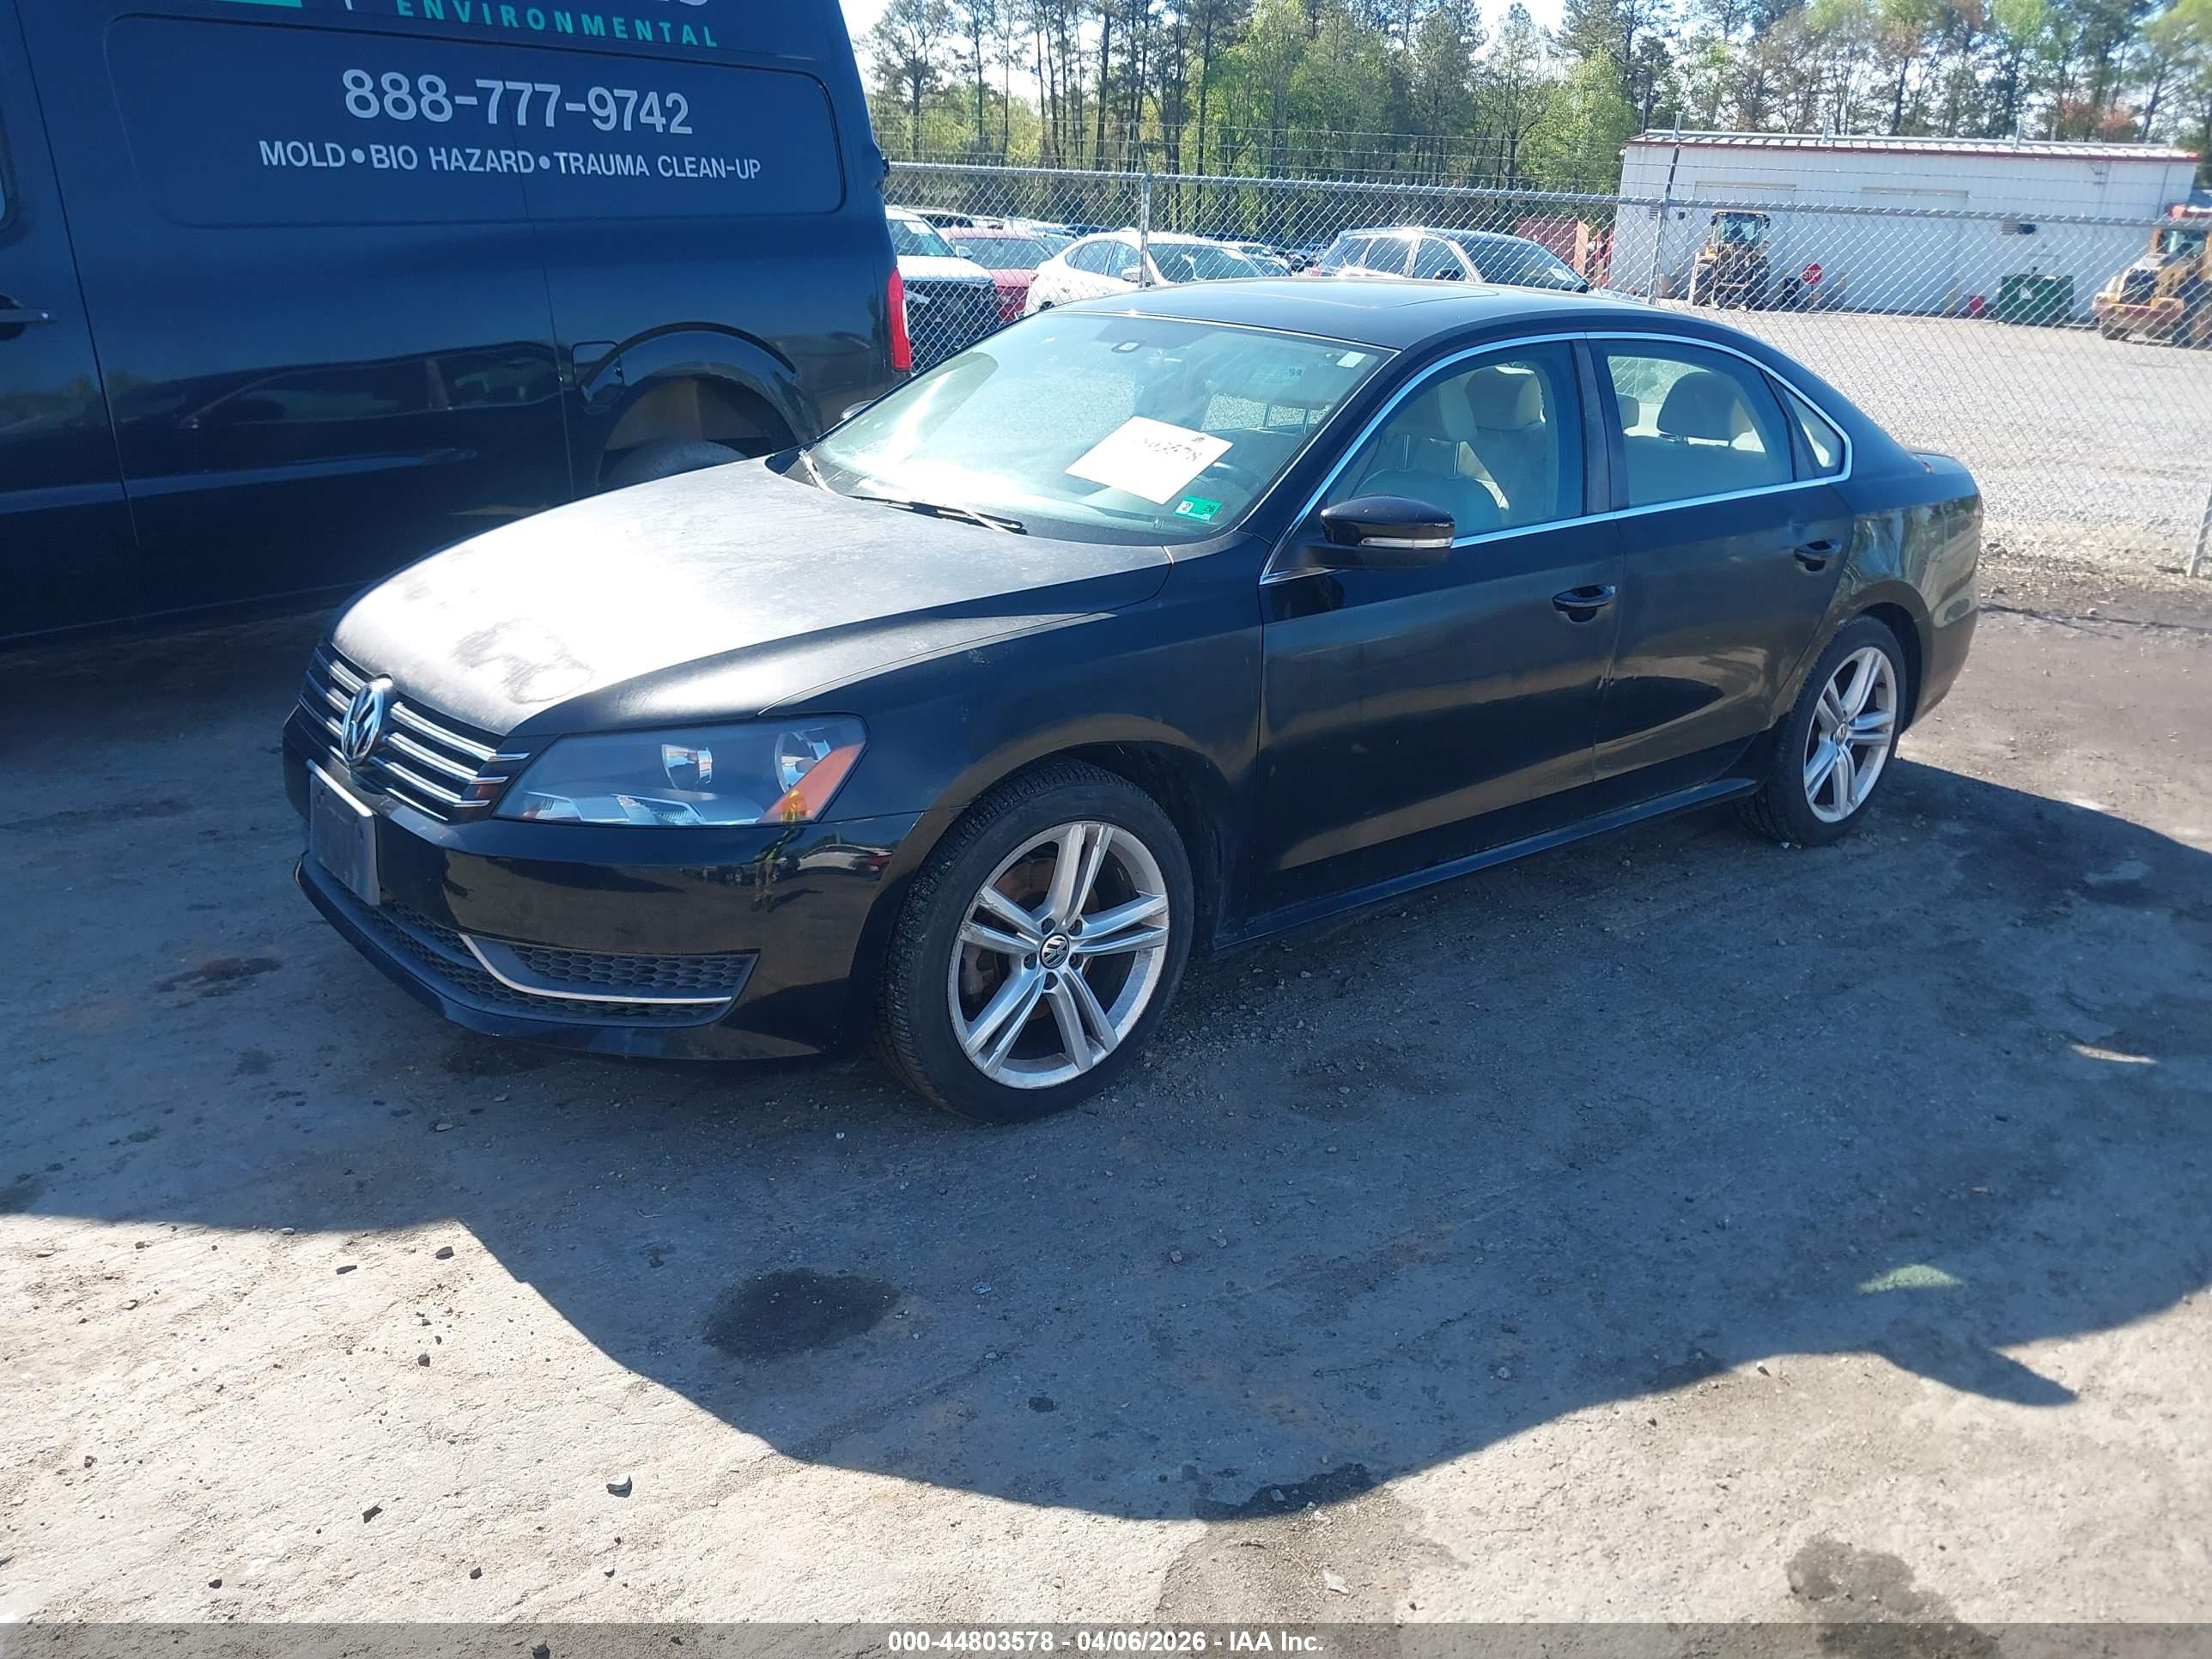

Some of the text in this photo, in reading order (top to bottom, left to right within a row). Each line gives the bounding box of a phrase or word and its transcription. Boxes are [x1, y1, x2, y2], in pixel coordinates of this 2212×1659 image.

[397, 0, 718, 46] ENVIRONMENTAL
[343, 69, 694, 135] 888-777-9742
[428, 146, 535, 173] HAZARD
[553, 151, 650, 177] TRAUMA
[657, 155, 762, 179] CLEAN-UP
[1182, 502, 1191, 511] 2
